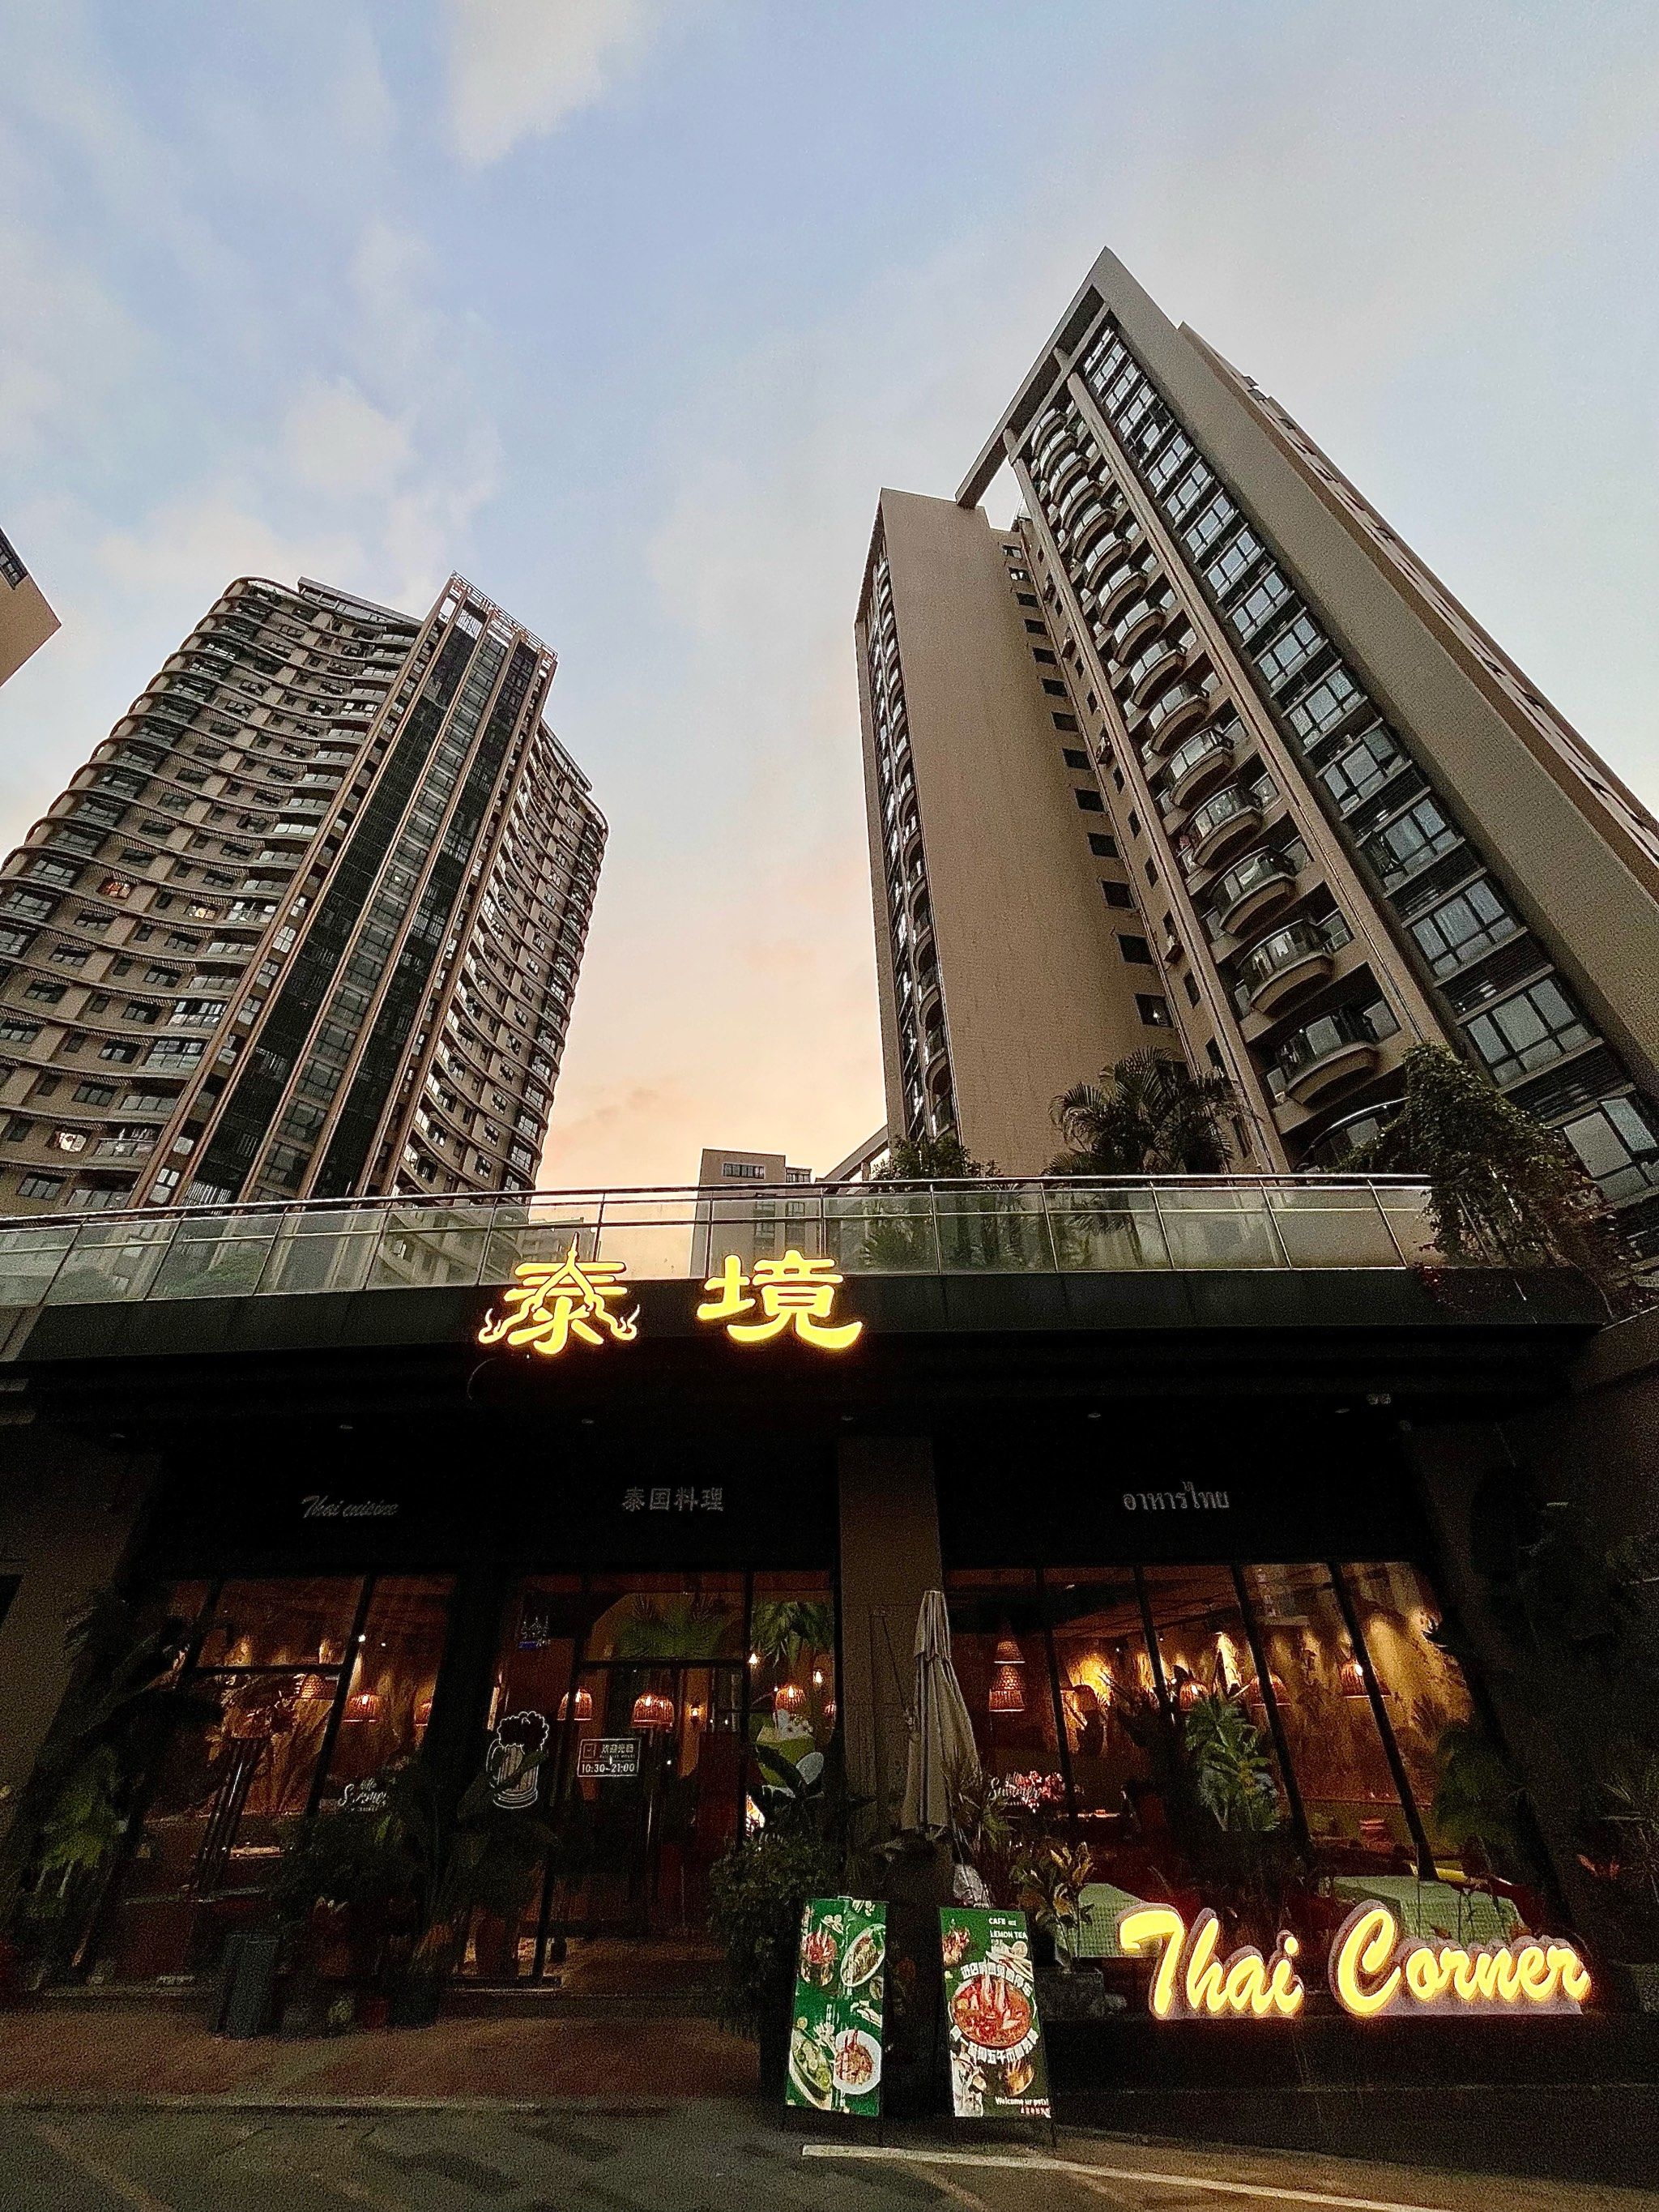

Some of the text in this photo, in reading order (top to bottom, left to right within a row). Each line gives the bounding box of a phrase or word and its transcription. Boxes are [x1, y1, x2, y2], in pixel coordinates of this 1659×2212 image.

[301, 1495, 399, 1518] Thai cuisine
[621, 1486, 723, 1511] 泰国料理
[1123, 1481, 1230, 1510] อาหารไทย
[989, 1917, 1006, 1925] CAFE
[990, 1930, 1029, 1941] LEMON TEA
[1117, 1902, 1592, 2017] Thai Corner
